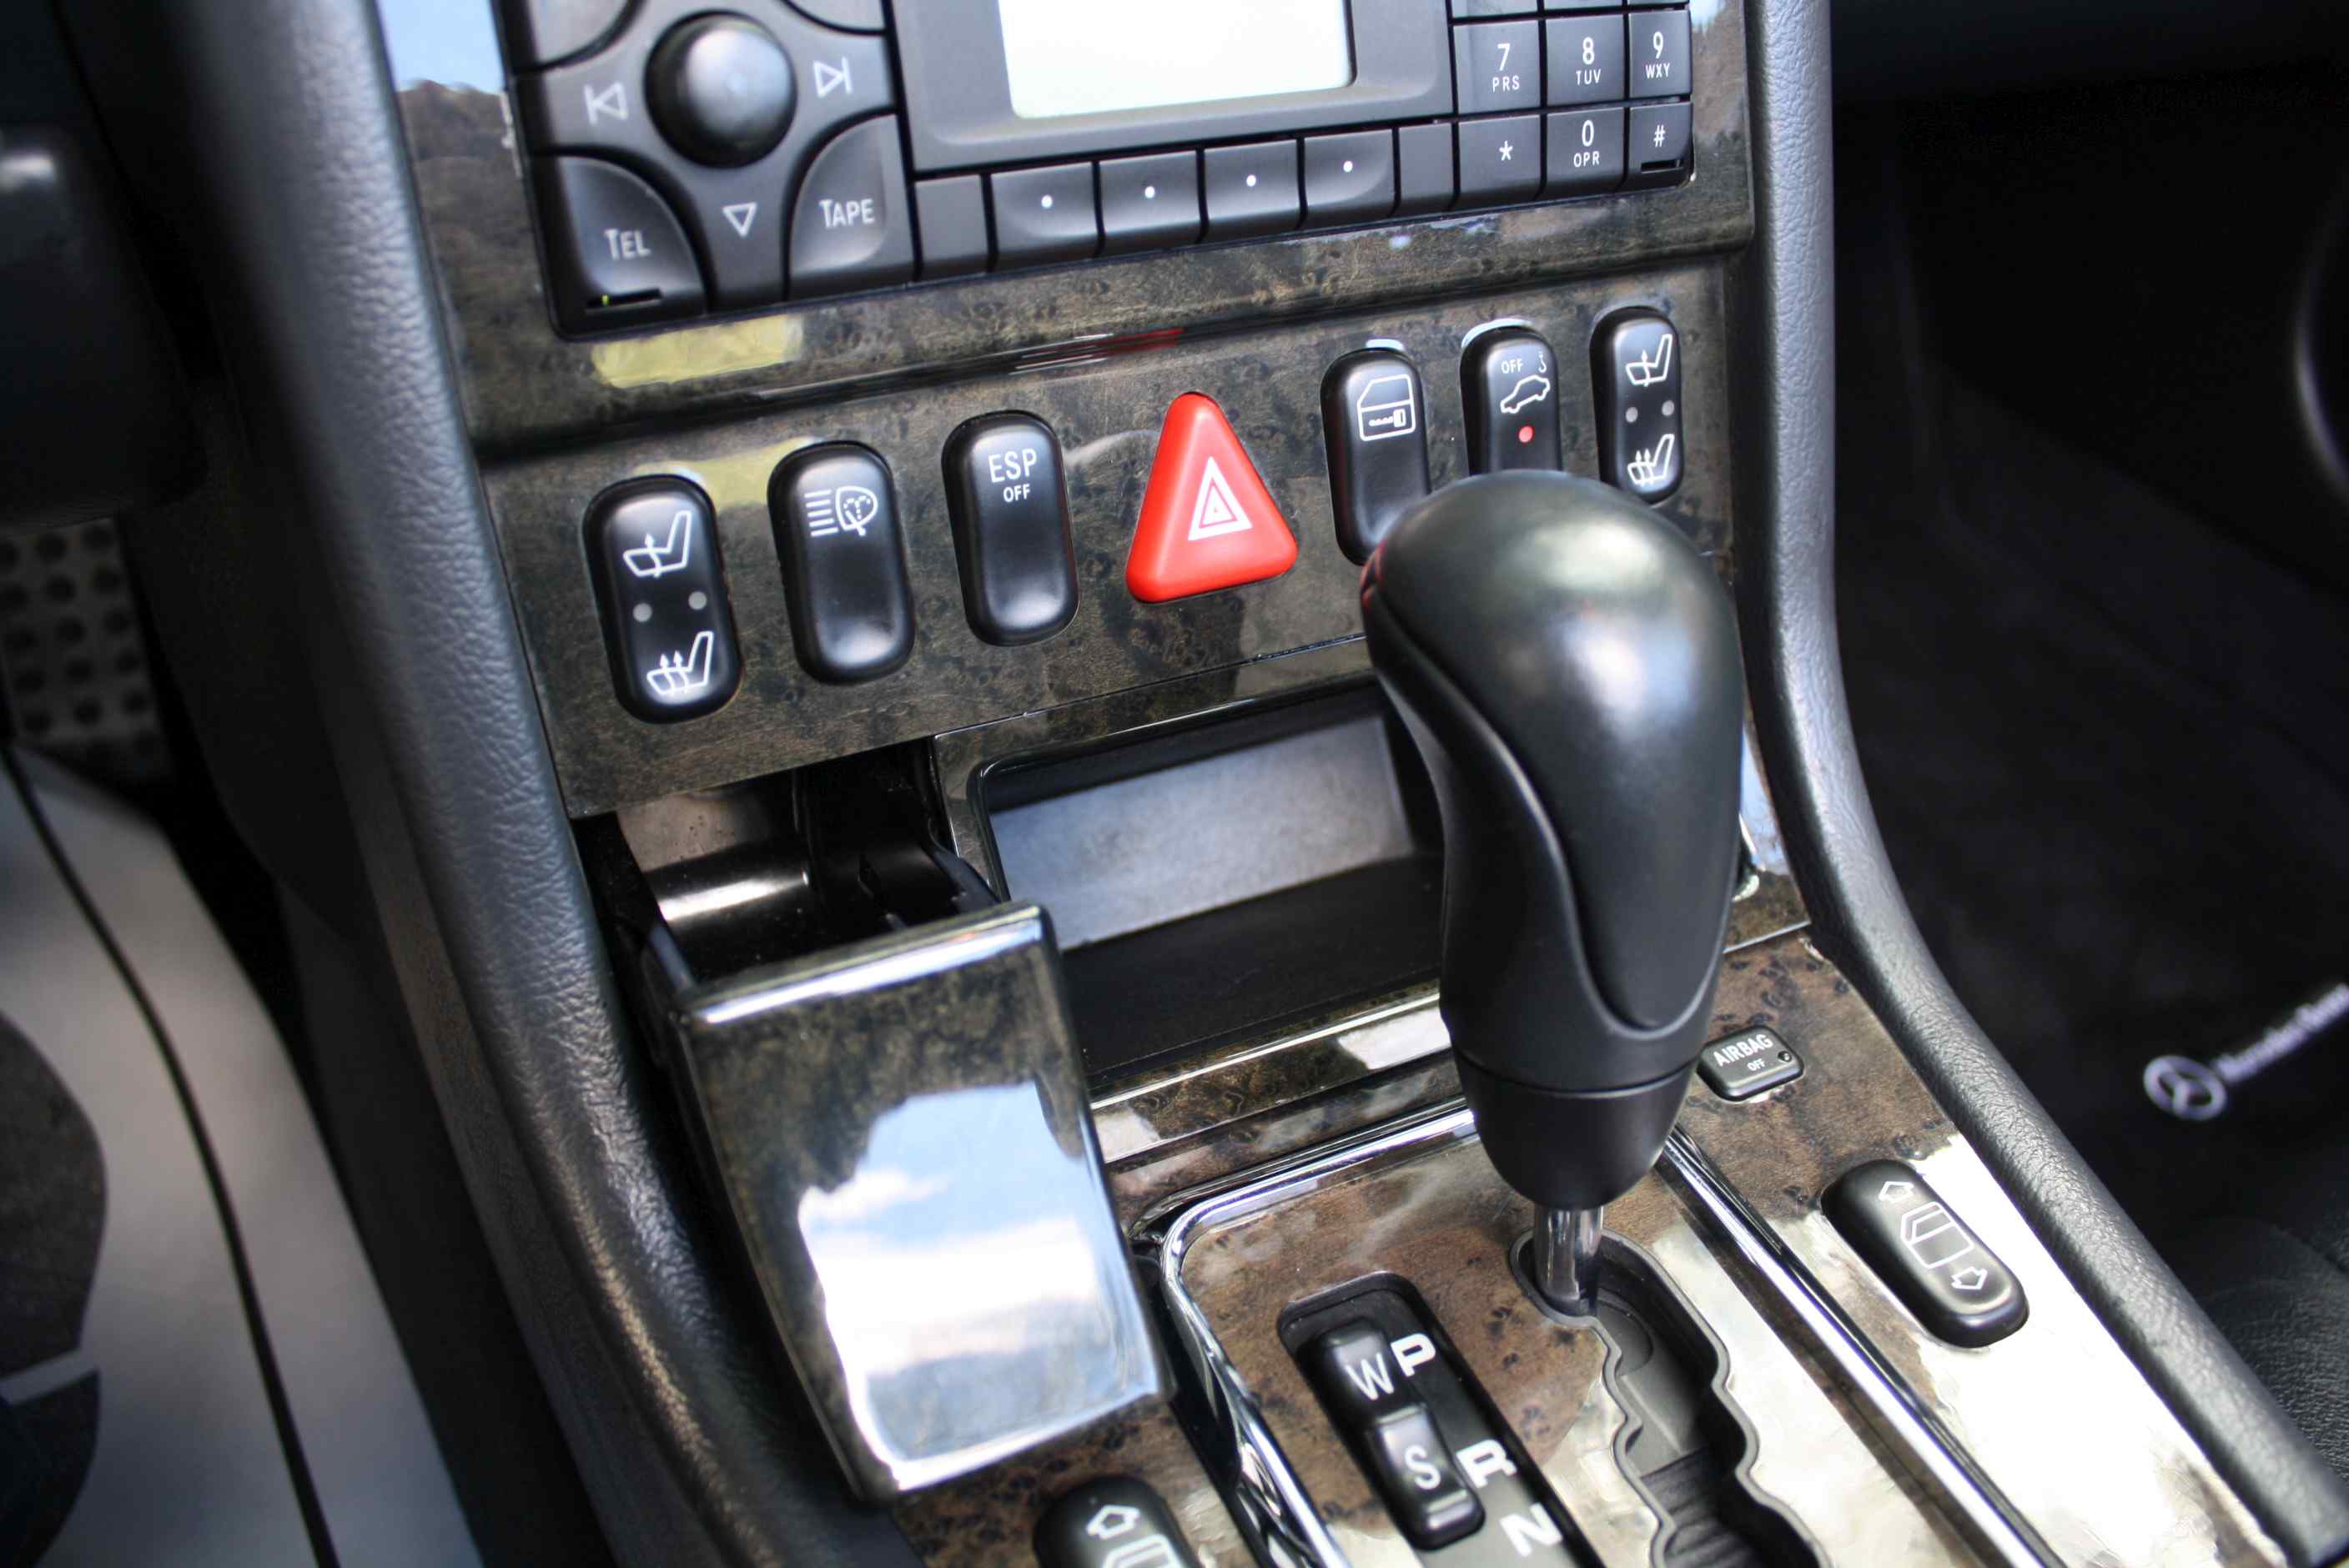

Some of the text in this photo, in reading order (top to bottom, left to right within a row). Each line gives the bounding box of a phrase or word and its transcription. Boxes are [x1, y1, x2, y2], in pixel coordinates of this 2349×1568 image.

[1497, 43, 1511, 71] 7
[1582, 37, 1595, 65] 8
[1652, 32, 1664, 59] 9
[1492, 76, 1520, 93] PRS
[1576, 69, 1602, 86] TUV
[1646, 63, 1670, 79] WXY
[1582, 120, 1594, 147] 0
[1653, 124, 1666, 148] #
[1574, 151, 1600, 168] OPR
[819, 199, 876, 229] TAPE
[605, 229, 651, 260] TEL
[1501, 359, 1524, 374] OFF
[988, 448, 1037, 483] ESP
[1003, 484, 1031, 503] OFF
[1713, 1033, 1773, 1067] AIRBAG
[1747, 1058, 1766, 1072] OFF
[1391, 1334, 1436, 1377] P
[1346, 1354, 1395, 1401] W
[1404, 1445, 1441, 1490] S
[1456, 1439, 1517, 1488] R
[1501, 1504, 1563, 1558] N
